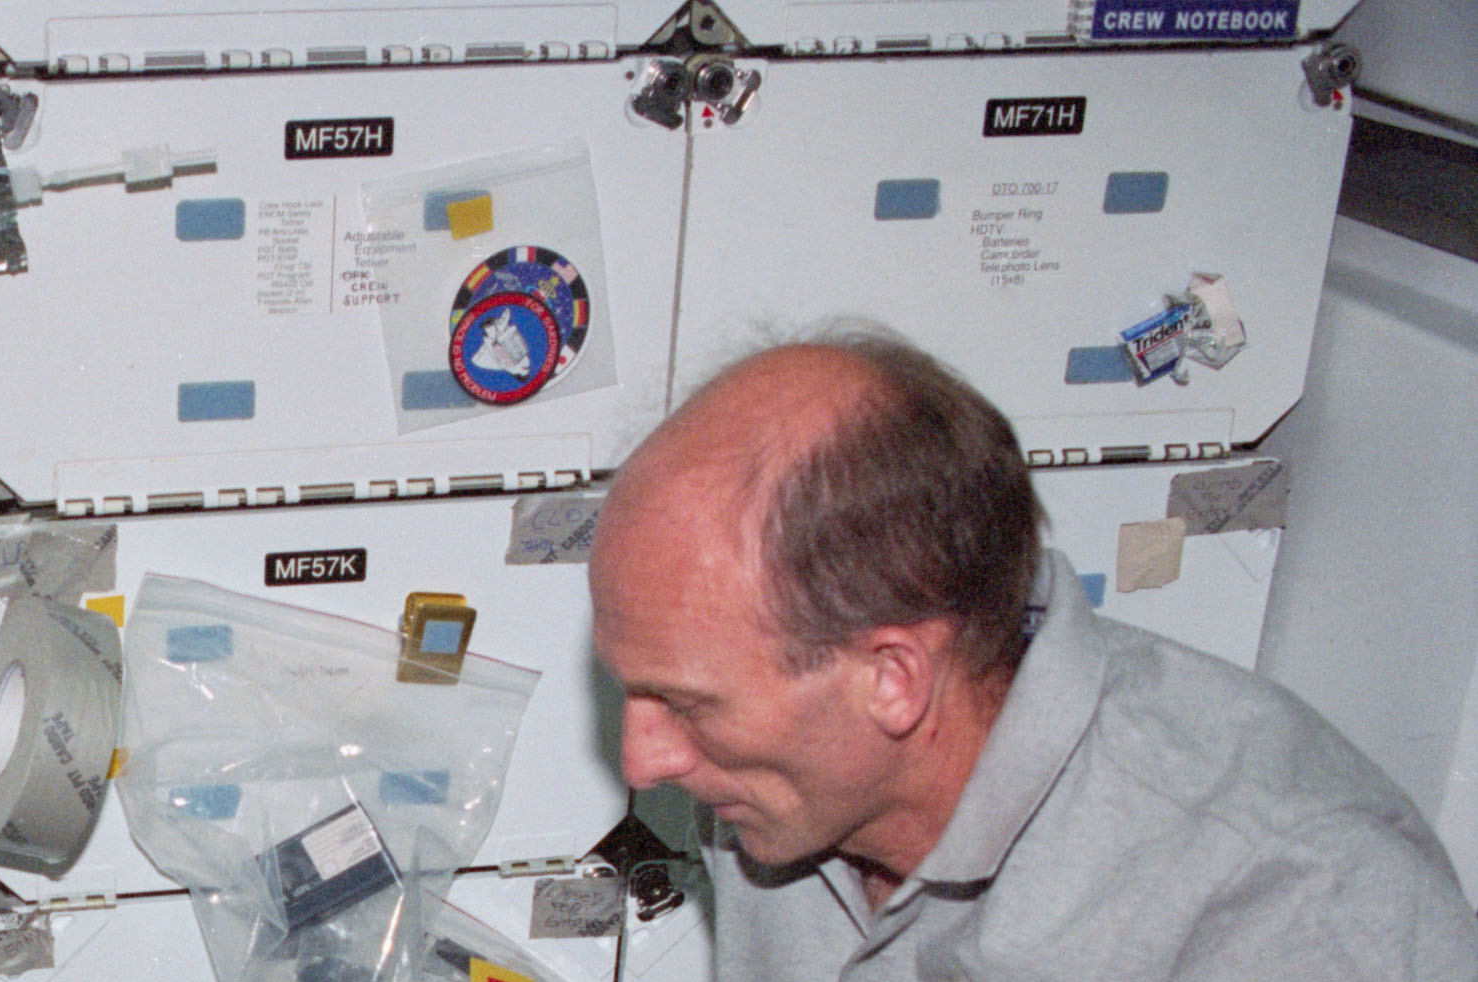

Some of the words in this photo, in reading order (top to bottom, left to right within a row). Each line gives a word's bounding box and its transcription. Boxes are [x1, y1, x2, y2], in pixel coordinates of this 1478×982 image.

[1102, 11, 1164, 30] CREW
[1175, 10, 1288, 29] NOTEBOOK
[993, 105, 1076, 128] MF71H
[296, 126, 383, 151] MF57H
[972, 209, 1015, 222] Bumper
[1018, 207, 1043, 221] Ring
[344, 230, 405, 246] Adjustable
[343, 293, 400, 307] SUPPORT
[274, 555, 358, 579] MF57K
